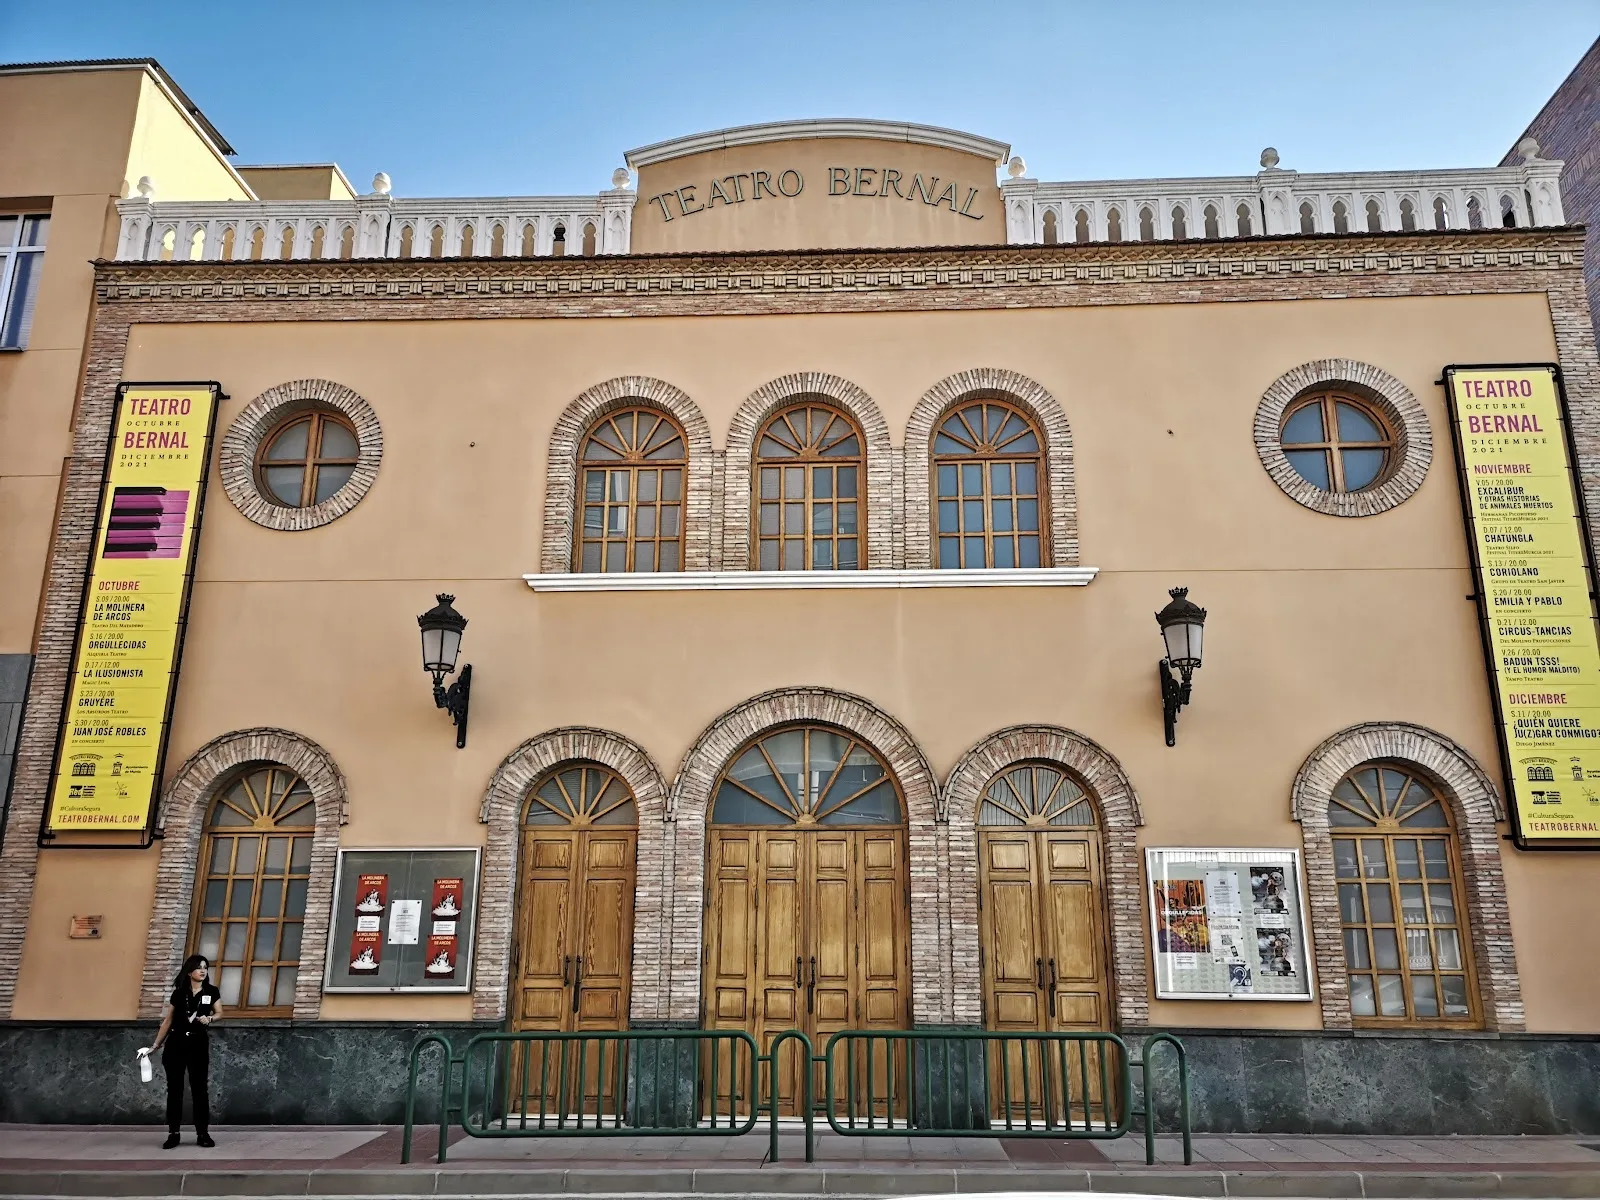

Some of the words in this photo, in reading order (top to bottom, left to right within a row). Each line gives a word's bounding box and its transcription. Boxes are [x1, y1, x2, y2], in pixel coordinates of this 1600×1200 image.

[649, 168, 805, 222] TEATRO
[828, 167, 984, 220] BERNAL
[1462, 379, 1532, 398] TEATRO
[130, 398, 191, 415] TEATRO
[1468, 414, 1543, 433] BERNAL
[124, 432, 189, 448] BERNAL
[1474, 464, 1532, 474] NOVIEMBRE
[1478, 487, 1524, 495] EXCALIBUR
[1485, 534, 1534, 542] CHATUNGLA
[1490, 568, 1539, 576] CORIOLANO
[98, 581, 140, 591] OCTUBRE
[1494, 597, 1524, 606] EMILIA
[1526, 597, 1531, 606] Y
[1535, 597, 1563, 606] PABLO
[1499, 627, 1572, 636] CIRCUS-TANCIAS
[88, 640, 146, 649] ORGULLECIDAS
[1504, 657, 1532, 666] BADUN
[1535, 657, 1560, 666] TSSS!
[1509, 694, 1567, 704] DICIEMBRE
[1548, 719, 1581, 728] QUIERE
[73, 727, 92, 736] JUAN
[94, 726, 113, 736] JOSÉ
[116, 727, 146, 736] ROBLES
[1514, 729, 1552, 739] JU(Z)GAR
[58, 815, 140, 823] TEATROBERNAL.COM
[1529, 822, 1599, 831] TEATROBERNAL
